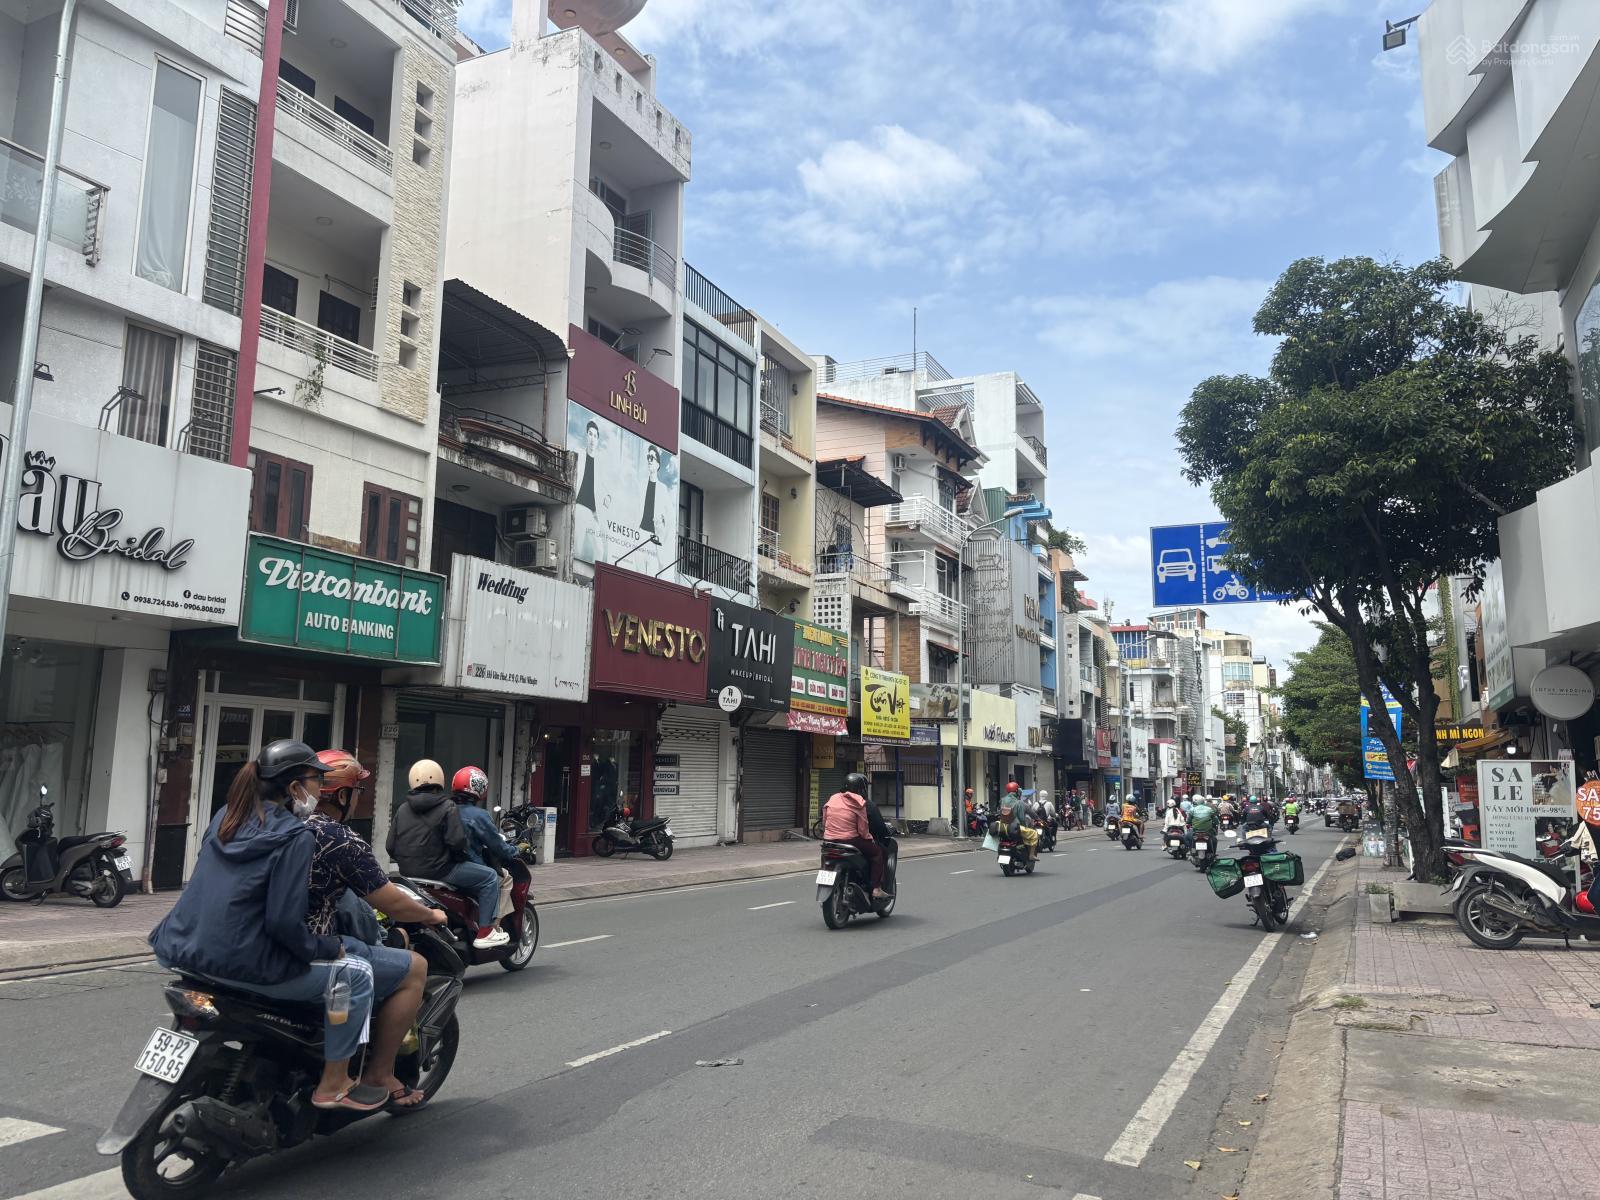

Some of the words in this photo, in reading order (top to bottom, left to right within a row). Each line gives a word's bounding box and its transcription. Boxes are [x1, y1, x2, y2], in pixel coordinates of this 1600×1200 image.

[610, 391, 632, 416] LINH
[633, 401, 648, 425] BÙI
[60, 508, 195, 571] Bridal
[607, 520, 640, 541] VENESTO
[207, 594, 226, 604] bridal
[258, 556, 433, 616] Vietcombank
[477, 572, 529, 604] Wedding
[304, 611, 339, 632] AUTO
[341, 615, 395, 640] BANKING
[601, 607, 706, 664] VENESTO
[731, 623, 777, 665] TAHI
[722, 697, 738, 705] TAHI
[1450, 726, 1460, 739] MÌ
[1462, 728, 1485, 739] NGON
[1491, 767, 1523, 783] SA
[1493, 785, 1523, 801] LE
[1485, 804, 1505, 813] VÁY
[1505, 804, 1524, 813] MỚI
[154, 1033, 190, 1059] 59-P2
[140, 1050, 182, 1079] 150.95
